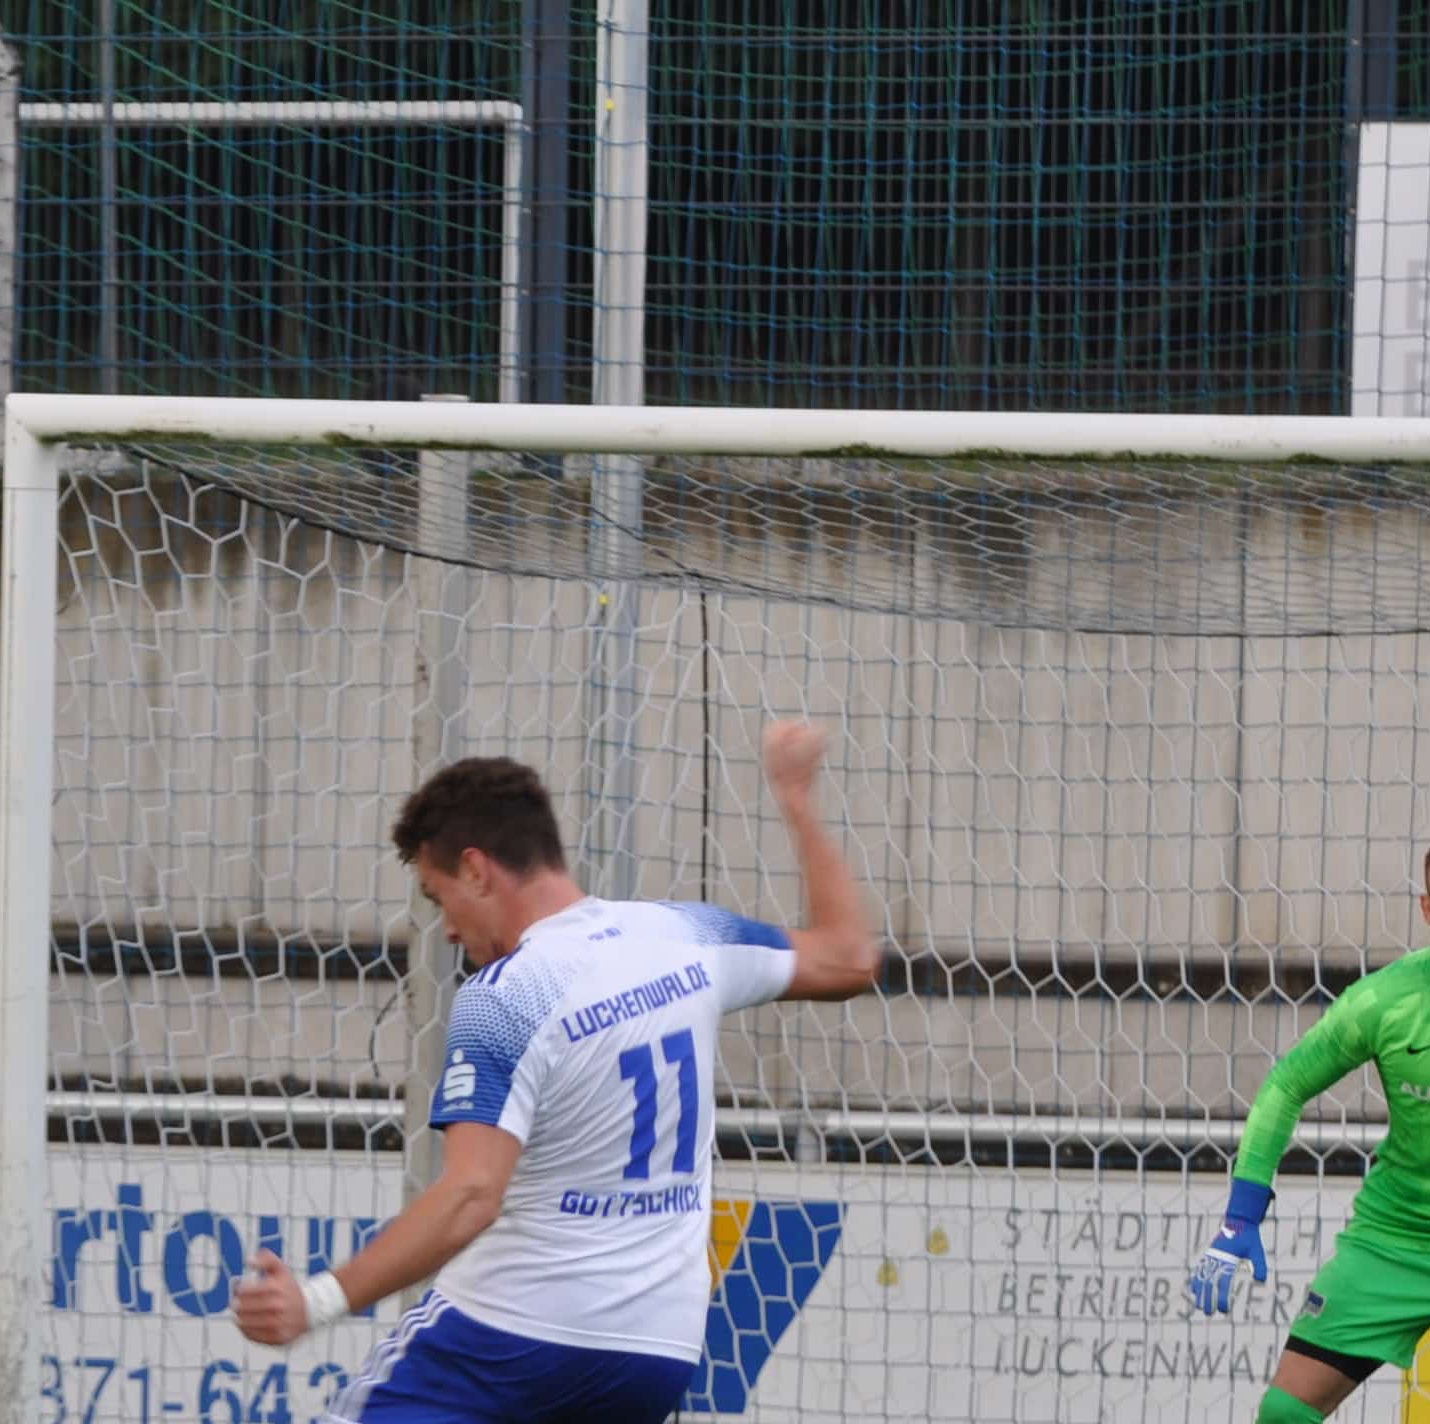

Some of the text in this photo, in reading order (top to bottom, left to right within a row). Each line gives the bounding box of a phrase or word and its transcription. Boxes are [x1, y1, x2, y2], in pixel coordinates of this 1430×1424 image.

[560, 961, 712, 1043] LUCKENWALDE
[618, 1027, 700, 1180] 11
[1001, 1199, 1320, 1257] STÄDTIH
[994, 1334, 1274, 1384] LUCKENWA
